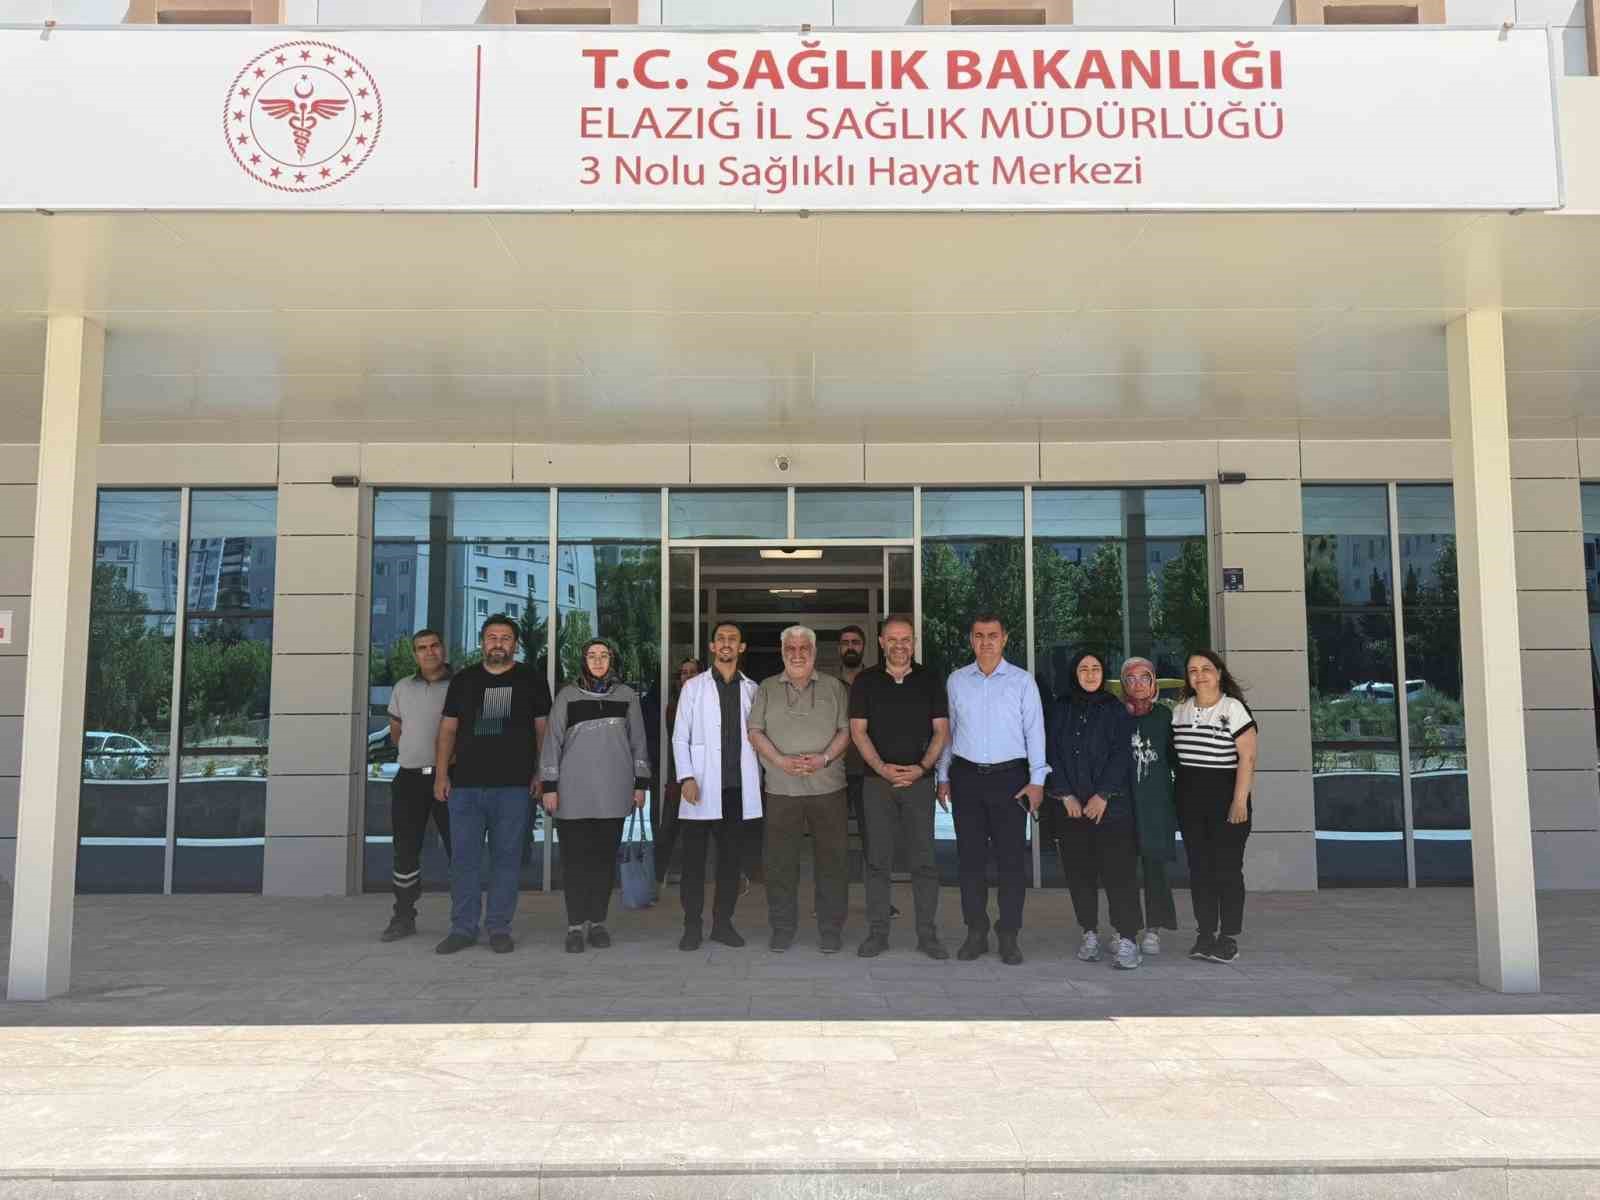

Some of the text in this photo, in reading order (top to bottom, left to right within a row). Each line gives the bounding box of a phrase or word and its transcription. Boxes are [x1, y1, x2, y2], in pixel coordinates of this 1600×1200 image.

[581, 40, 1284, 91] T.C. SAĞLIK BAKANLIĞI
[580, 101, 1285, 141] ELAZIĞ İL SAĞLIK MÜDÜRLÜĞÜ
[580, 155, 1143, 194] 3 Nolu Sağlıklı Hayat Merkezi
